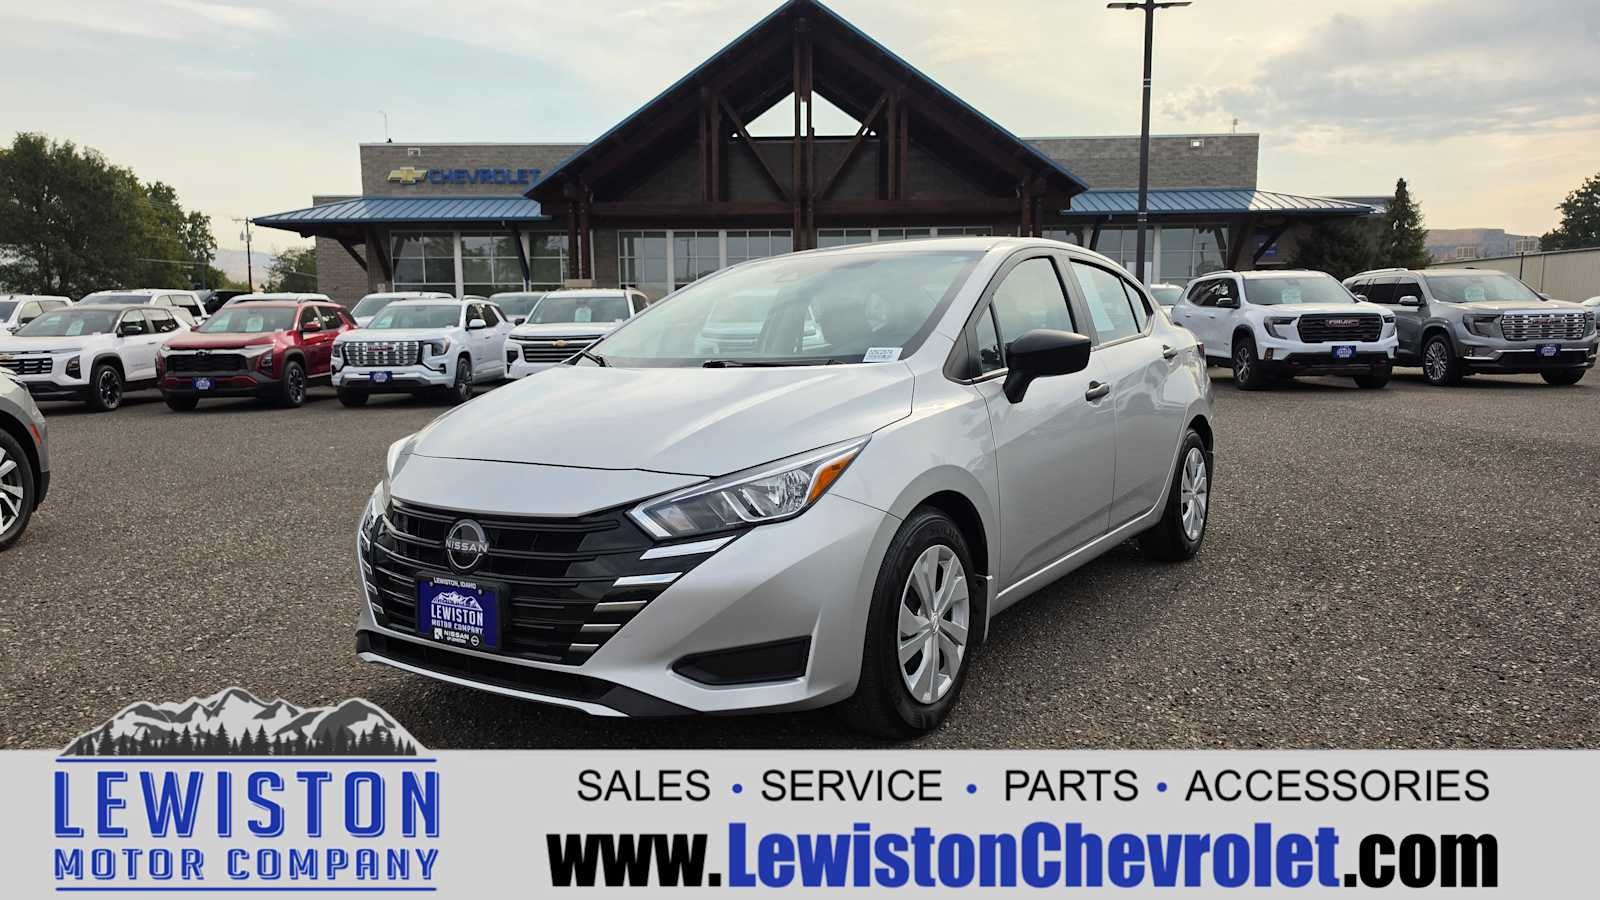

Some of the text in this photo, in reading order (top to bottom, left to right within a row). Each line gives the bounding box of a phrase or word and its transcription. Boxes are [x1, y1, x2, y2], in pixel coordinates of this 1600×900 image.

[428, 168, 541, 185] CHEVROLET
[445, 539, 488, 553] NISSAN
[431, 604, 483, 627] LEWISTON
[431, 619, 484, 636] MOTOR COMPANY
[443, 630, 470, 640] NISSAN
